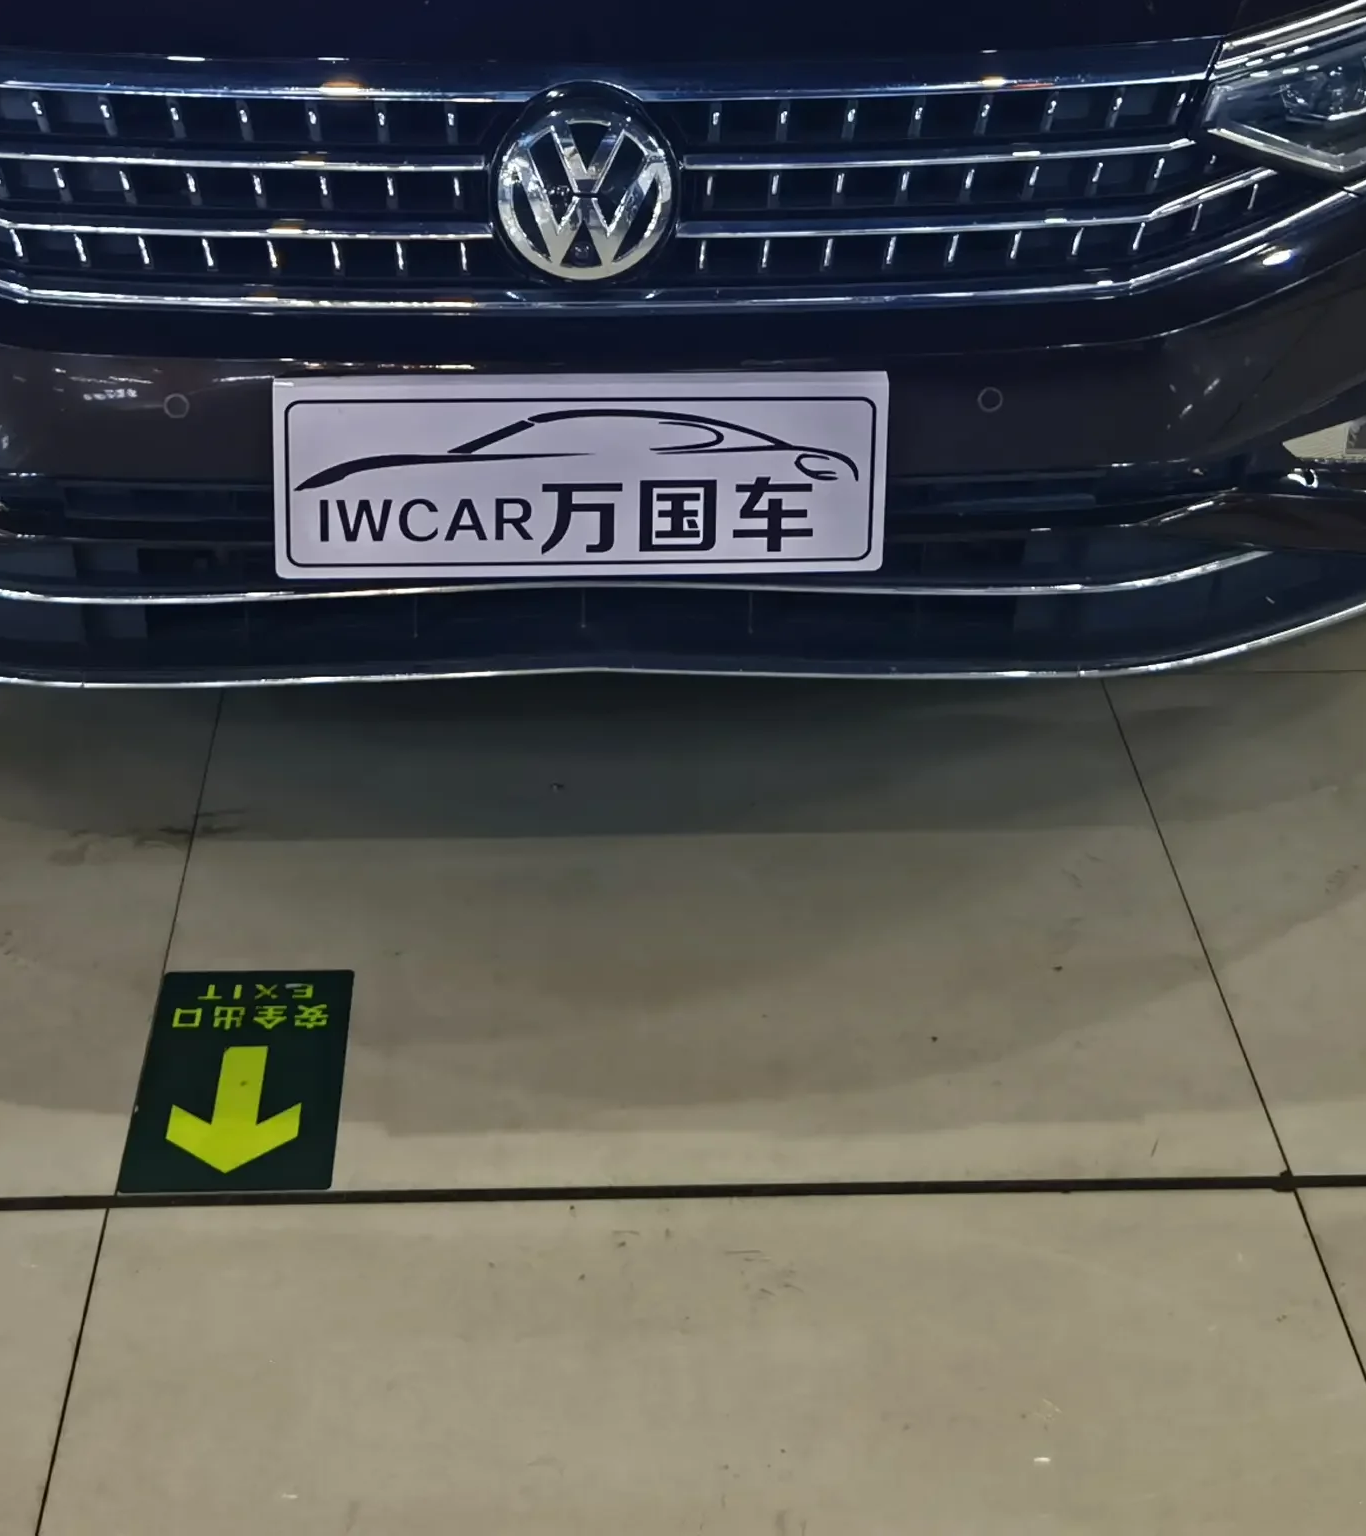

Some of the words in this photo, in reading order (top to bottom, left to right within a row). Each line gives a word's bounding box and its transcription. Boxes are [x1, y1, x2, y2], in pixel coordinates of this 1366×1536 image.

[197, 983, 314, 1001] EXIT
[172, 1004, 329, 1030] 安全出口
